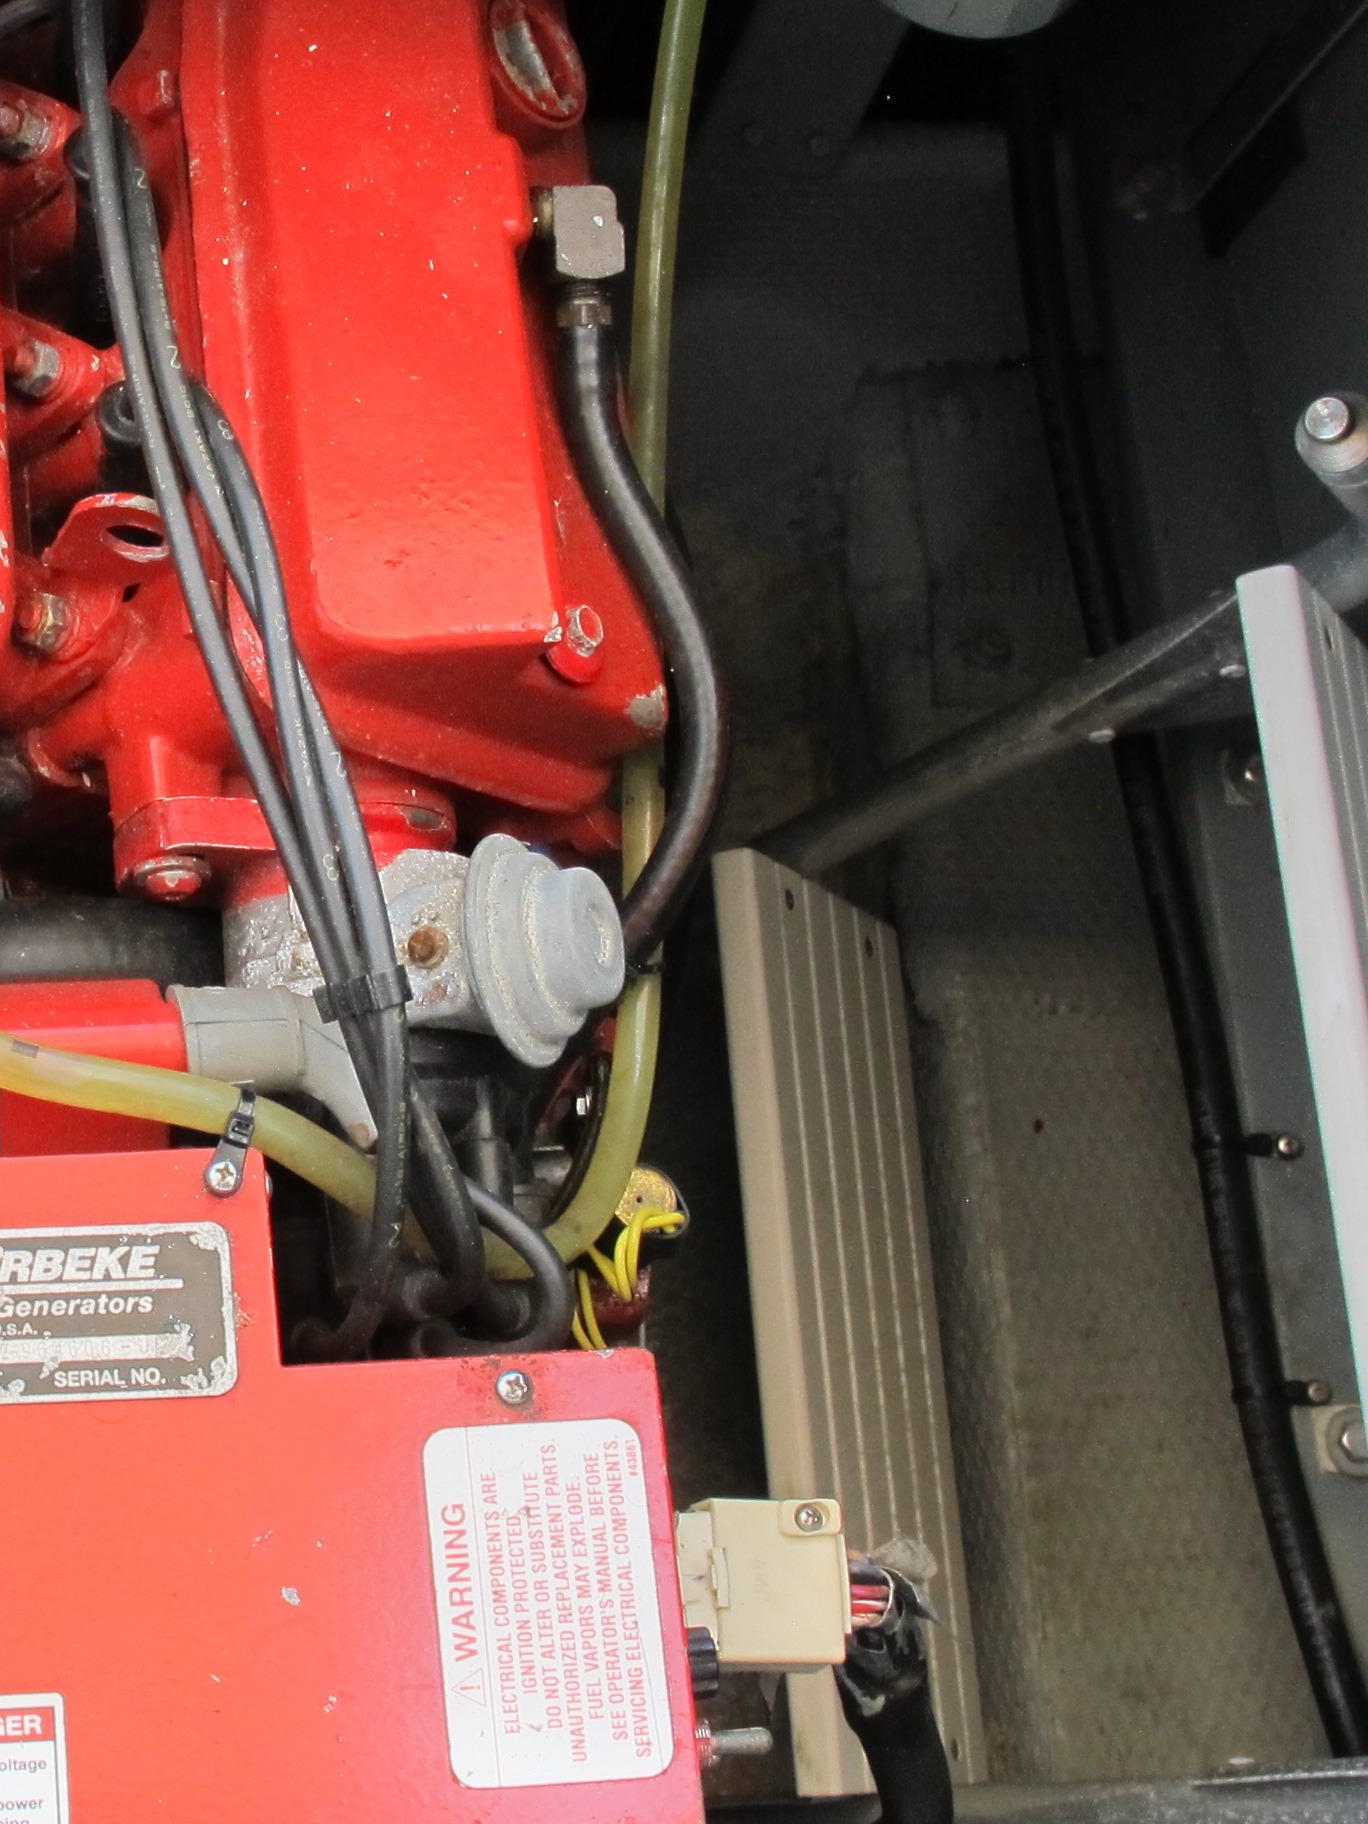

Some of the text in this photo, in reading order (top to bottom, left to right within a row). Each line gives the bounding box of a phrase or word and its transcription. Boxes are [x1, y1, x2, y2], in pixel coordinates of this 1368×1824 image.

[54, 1367, 167, 1387] SERIAL NO.
[440, 1503, 478, 1662] WARNING
[480, 1473, 520, 1733] ELECTRICAL COMPONENTS ARE
[522, 1473, 562, 1728] DO NOT ALTER OR SUBSTITUTE
[546, 1503, 573, 1623] REPLACEMENT
[573, 1563, 591, 1598] MAY
[583, 1453, 628, 1740] SEE OPERATOR'S MANUAL BEFORE
[616, 1561, 641, 1660] ELECTRICAL
[515, 1619, 537, 1693] IGNITION
[578, 1604, 599, 1672] VAPORS
[559, 1630, 587, 1763] UNAUTHORIZED
[586, 1678, 604, 1719] FUEL
[627, 1667, 651, 1757] SERVICING
